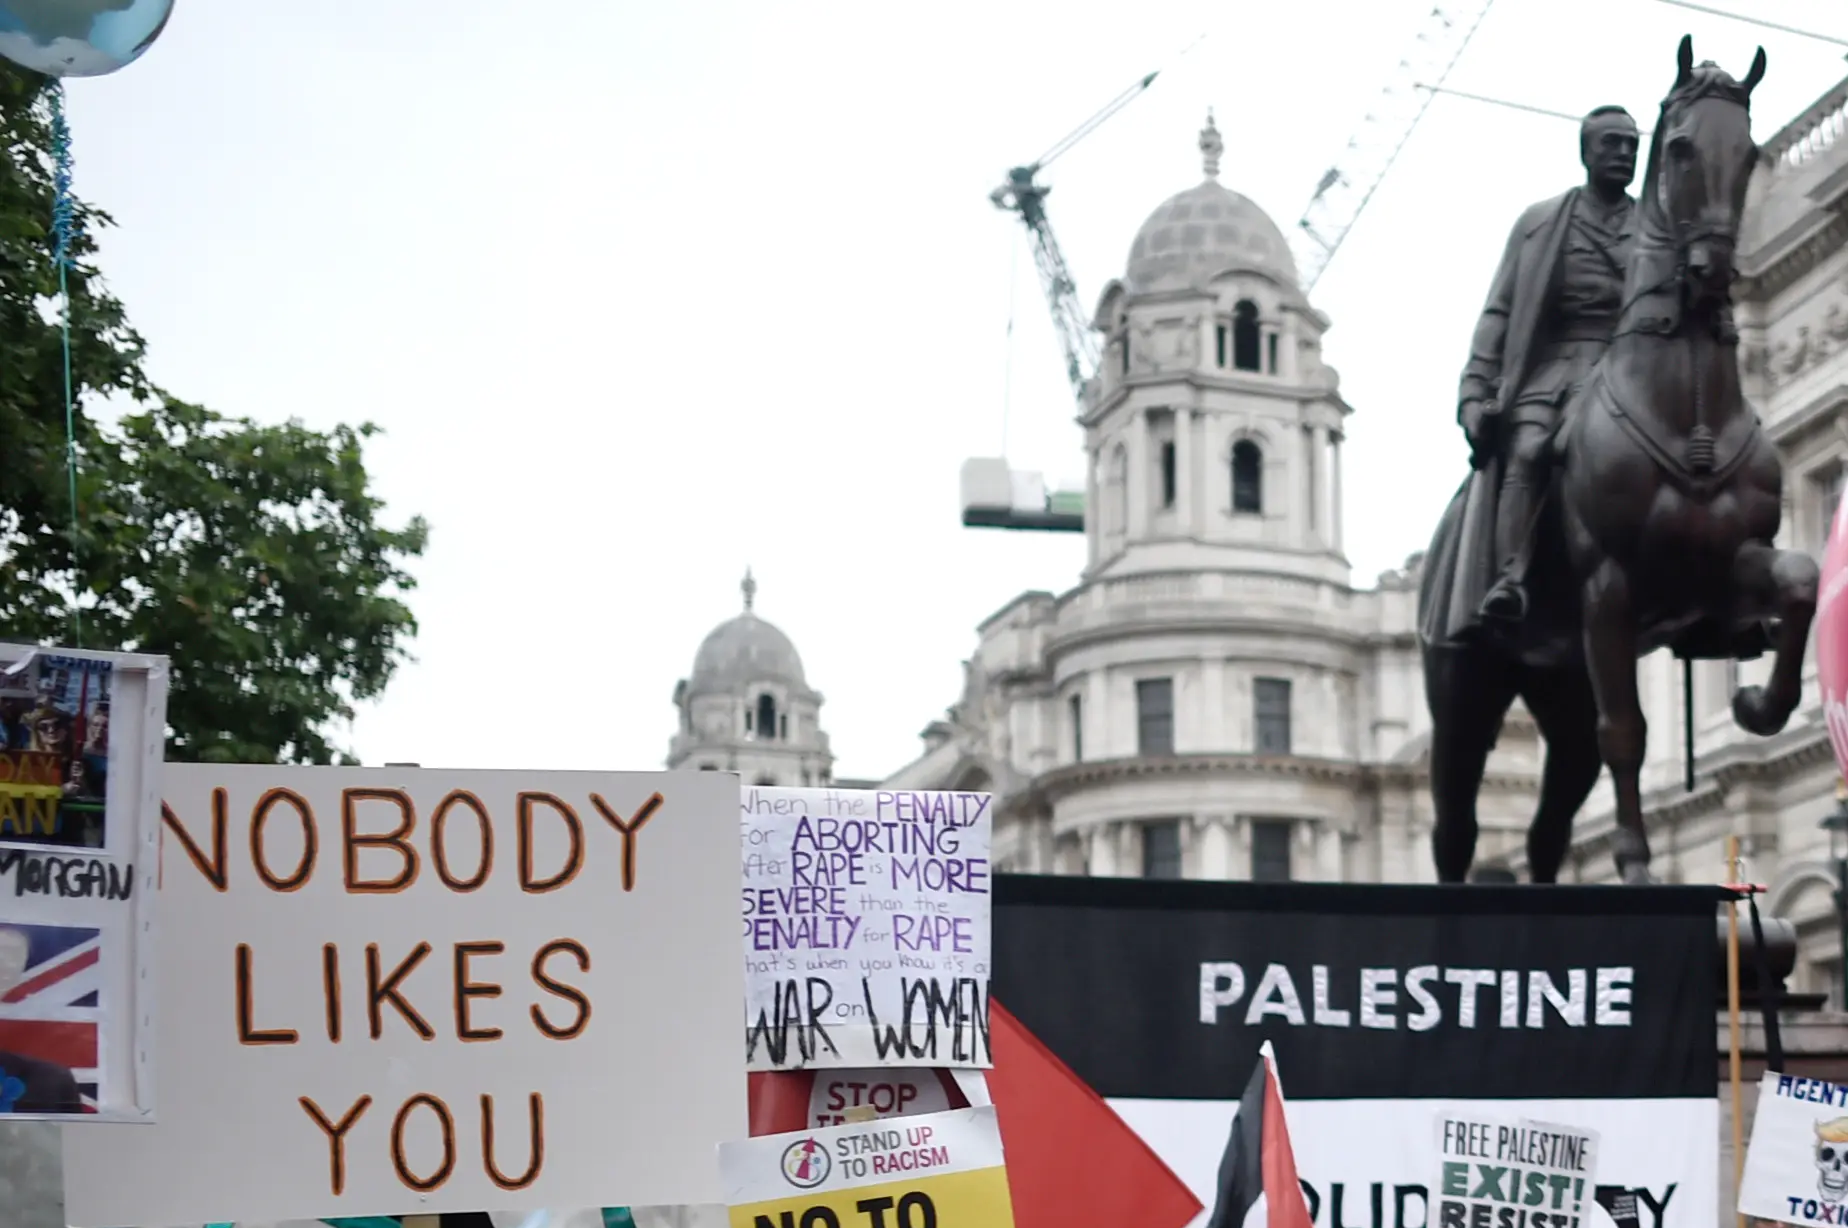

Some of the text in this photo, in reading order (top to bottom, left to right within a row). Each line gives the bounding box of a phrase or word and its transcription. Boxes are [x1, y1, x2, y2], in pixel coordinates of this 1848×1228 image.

[823, 790, 868, 816] the
[876, 792, 992, 828] PENALTY
[158, 787, 663, 893] NOBODY
[790, 815, 960, 856] ABORTING
[792, 851, 867, 886] RAPE
[869, 859, 883, 875] is
[891, 856, 989, 894] MORE
[742, 886, 949, 915] SEVERE than the
[863, 928, 890, 945] for
[893, 914, 973, 953] RAPE
[806, 953, 848, 970] when
[859, 958, 893, 979] you
[899, 952, 936, 970] know
[236, 938, 592, 1044] LIKES
[1198, 961, 1635, 1033] PALESTINE
[745, 975, 993, 1068] WAR on WOMEN
[827, 1081, 918, 1113] STOP
[299, 1093, 543, 1195] YOU
[836, 1126, 934, 1157] STAND UP
[1443, 1119, 1590, 1172] FREE PALESTINE
[838, 1146, 950, 1180] TO RACISM
[1441, 1161, 1586, 1212] EXIST!
